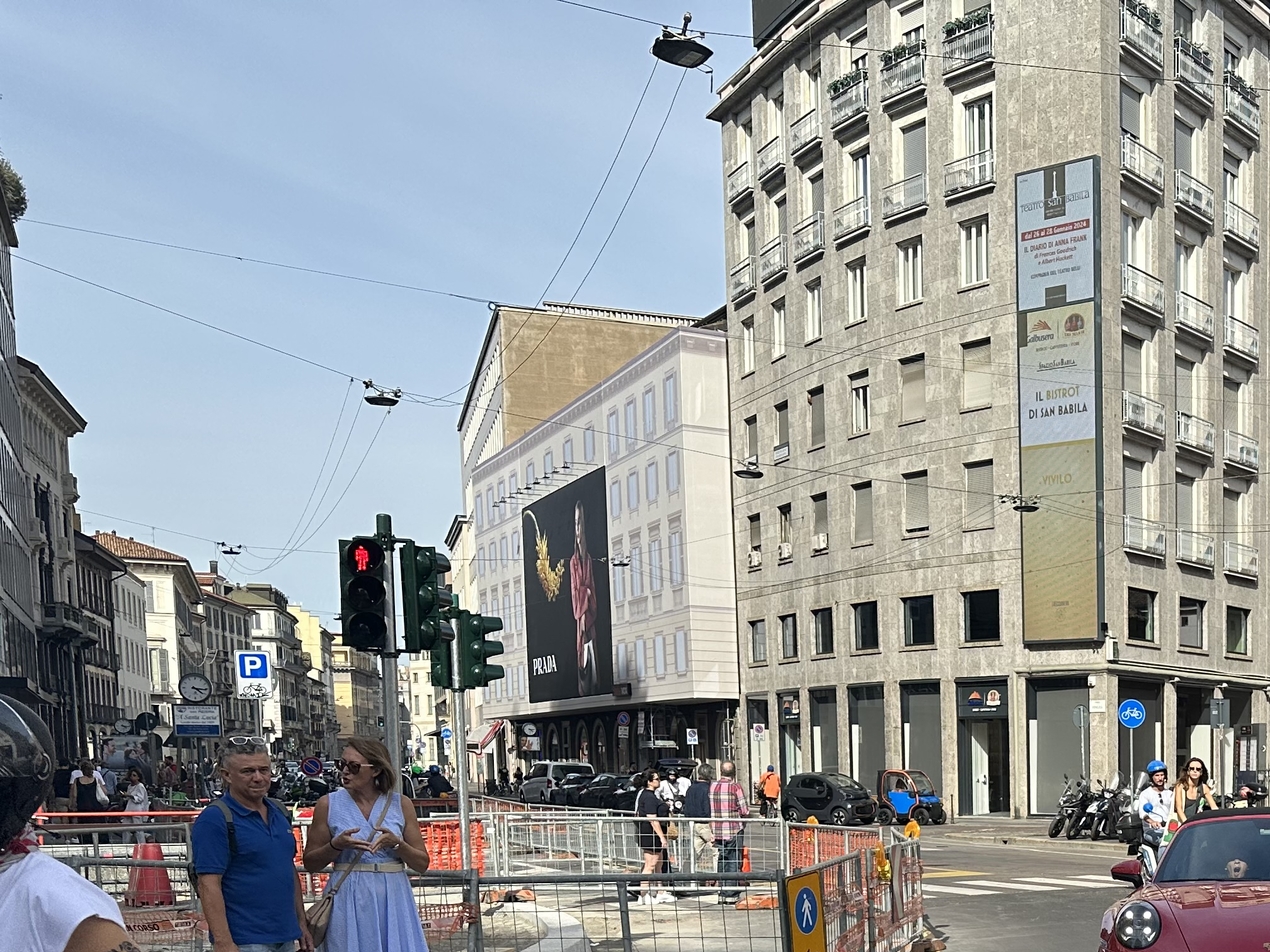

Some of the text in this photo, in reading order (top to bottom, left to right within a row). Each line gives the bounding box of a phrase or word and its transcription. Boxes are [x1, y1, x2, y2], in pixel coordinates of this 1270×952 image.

[1054, 224, 1073, 233] Gennaio
[1074, 221, 1087, 229] 2024
[1030, 242, 1047, 252] DIARIO
[1054, 239, 1069, 247] ANNA
[1070, 234, 1087, 244] FRANK
[1057, 246, 1077, 255] Goodrich
[1035, 386, 1080, 402] IL BISTROT
[1029, 402, 1088, 419] DI SAN BABILA
[1042, 473, 1072, 485] VIVILO
[244, 656, 261, 676] P
[533, 655, 557, 675] PRADA
